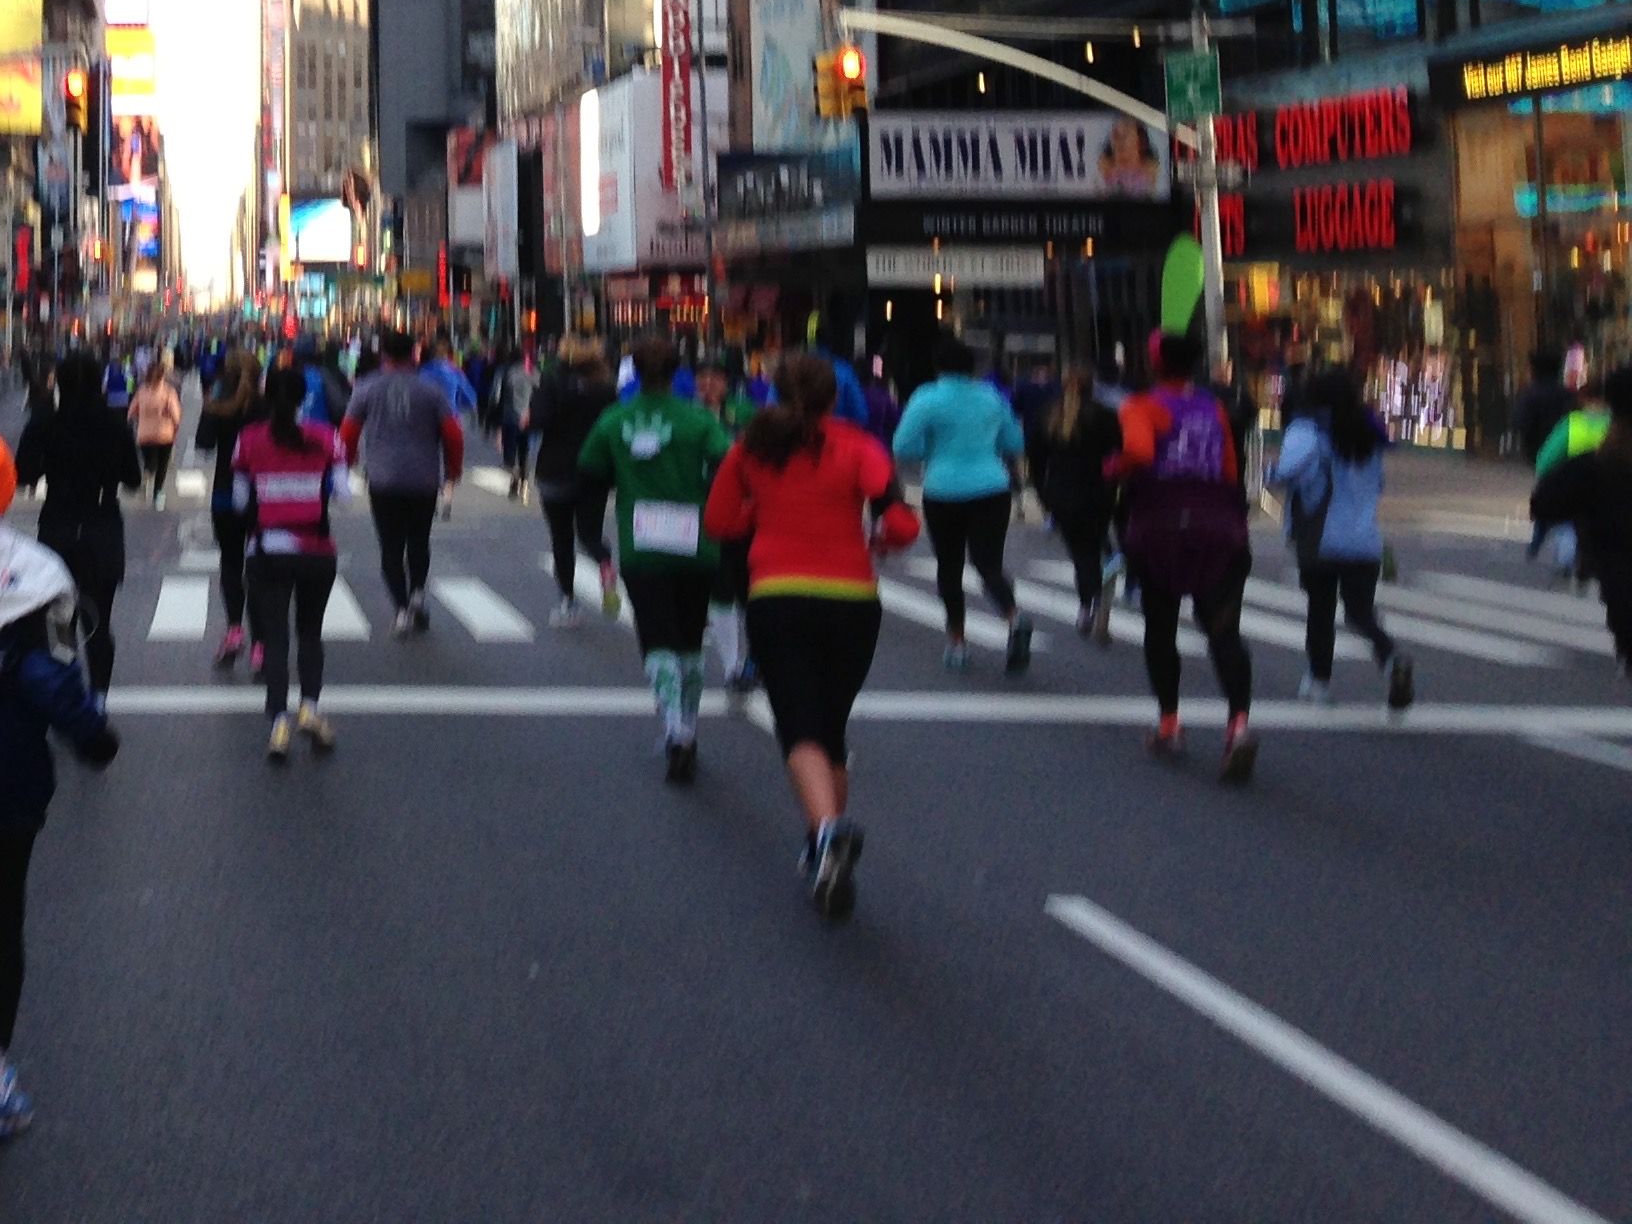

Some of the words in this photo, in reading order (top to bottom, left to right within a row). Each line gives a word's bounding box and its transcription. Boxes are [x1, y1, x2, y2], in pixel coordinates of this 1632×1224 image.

[1525, 50, 1560, 90] James
[1561, 41, 1591, 85] Bond
[879, 125, 1004, 182] MAMMA
[1013, 125, 1086, 181] MIA!
[1275, 83, 1411, 170] COMPUTERS
[1295, 177, 1395, 254] LUGGAGE
